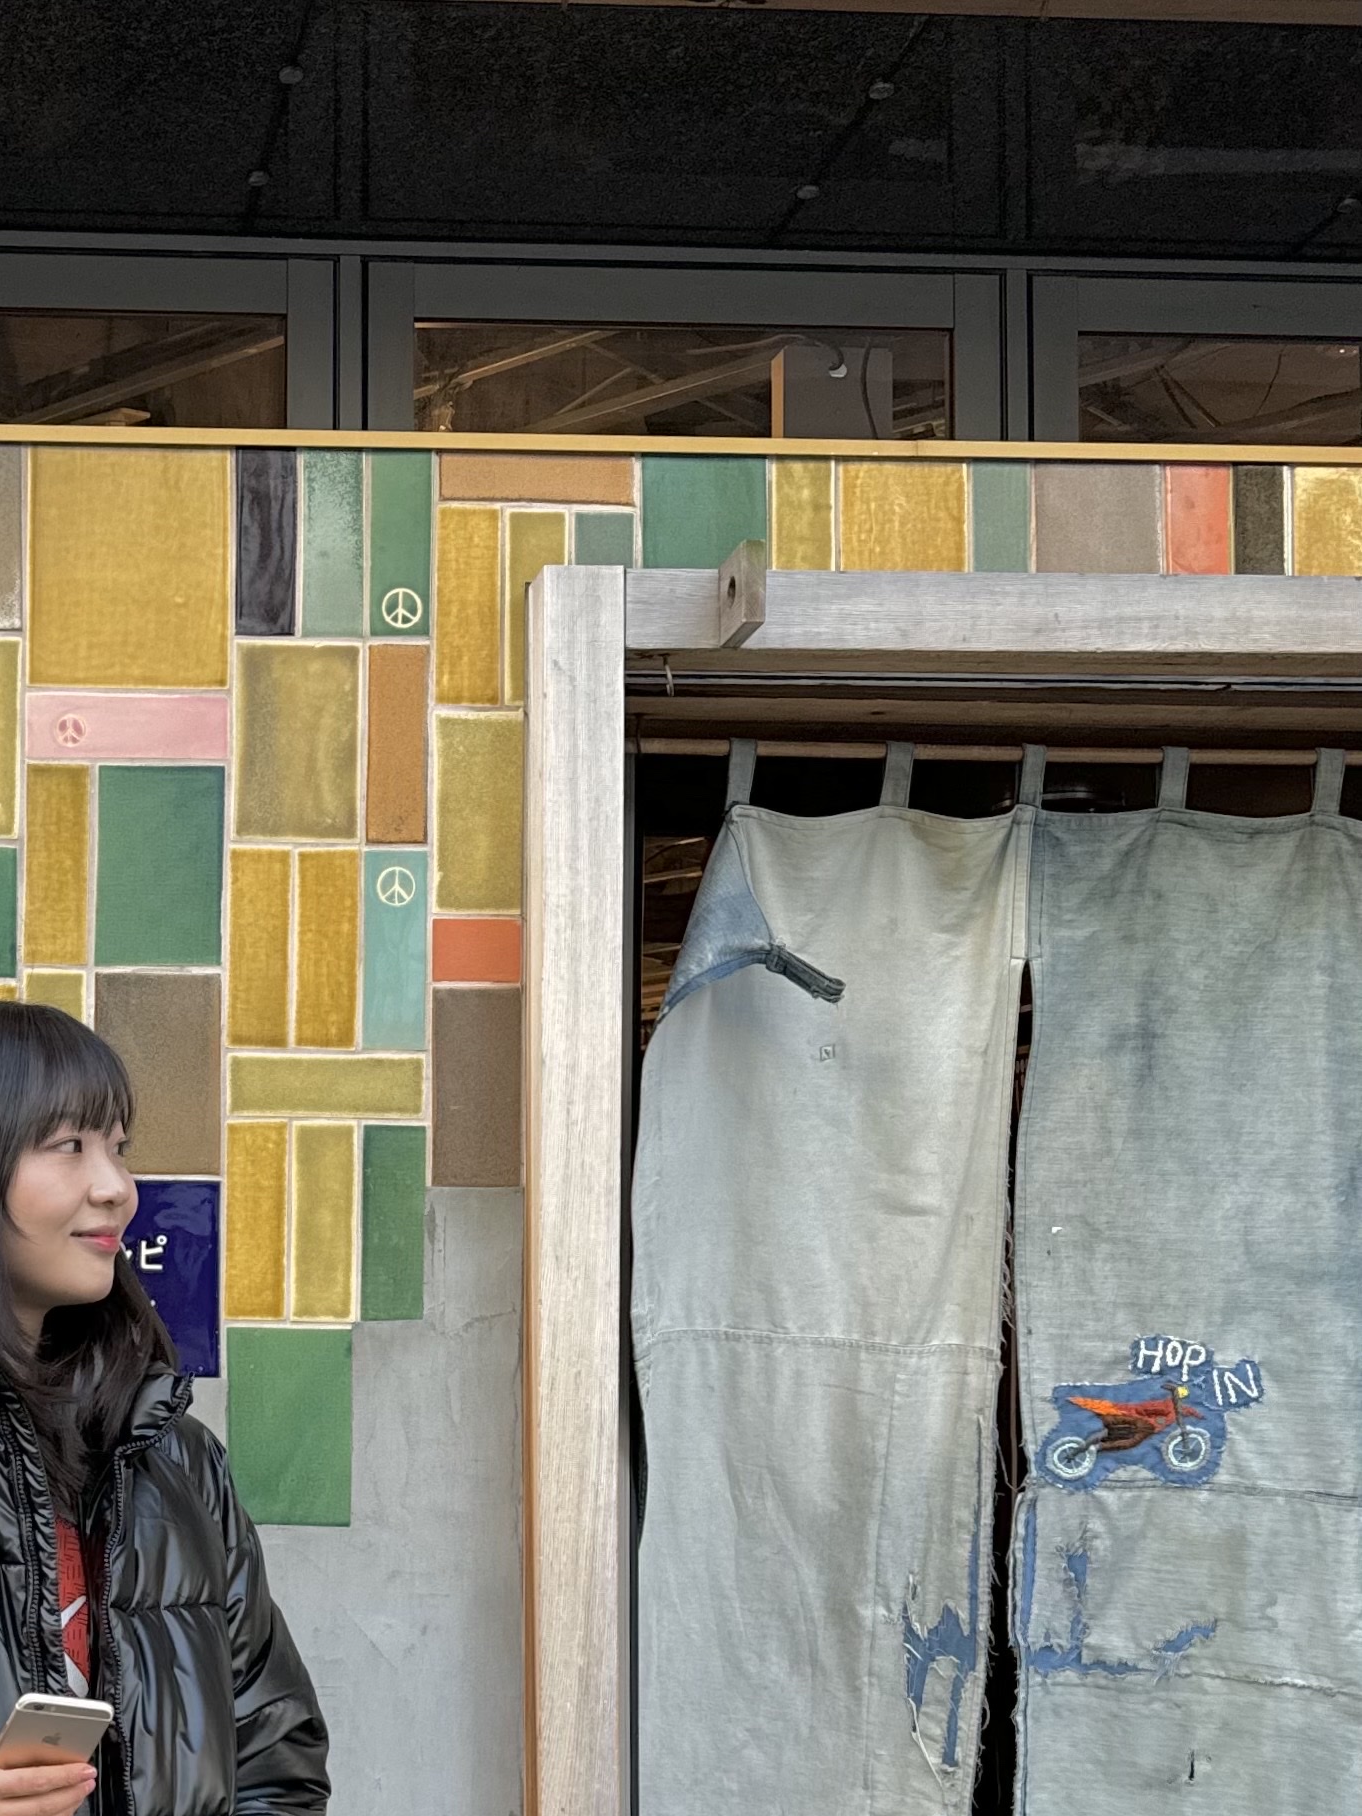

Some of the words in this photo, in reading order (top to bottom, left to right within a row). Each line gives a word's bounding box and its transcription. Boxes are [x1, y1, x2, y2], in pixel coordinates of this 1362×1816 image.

[121, 1234, 168, 1270] ピ
[1136, 1338, 1207, 1383] HOP
[1211, 1362, 1260, 1406] IN
